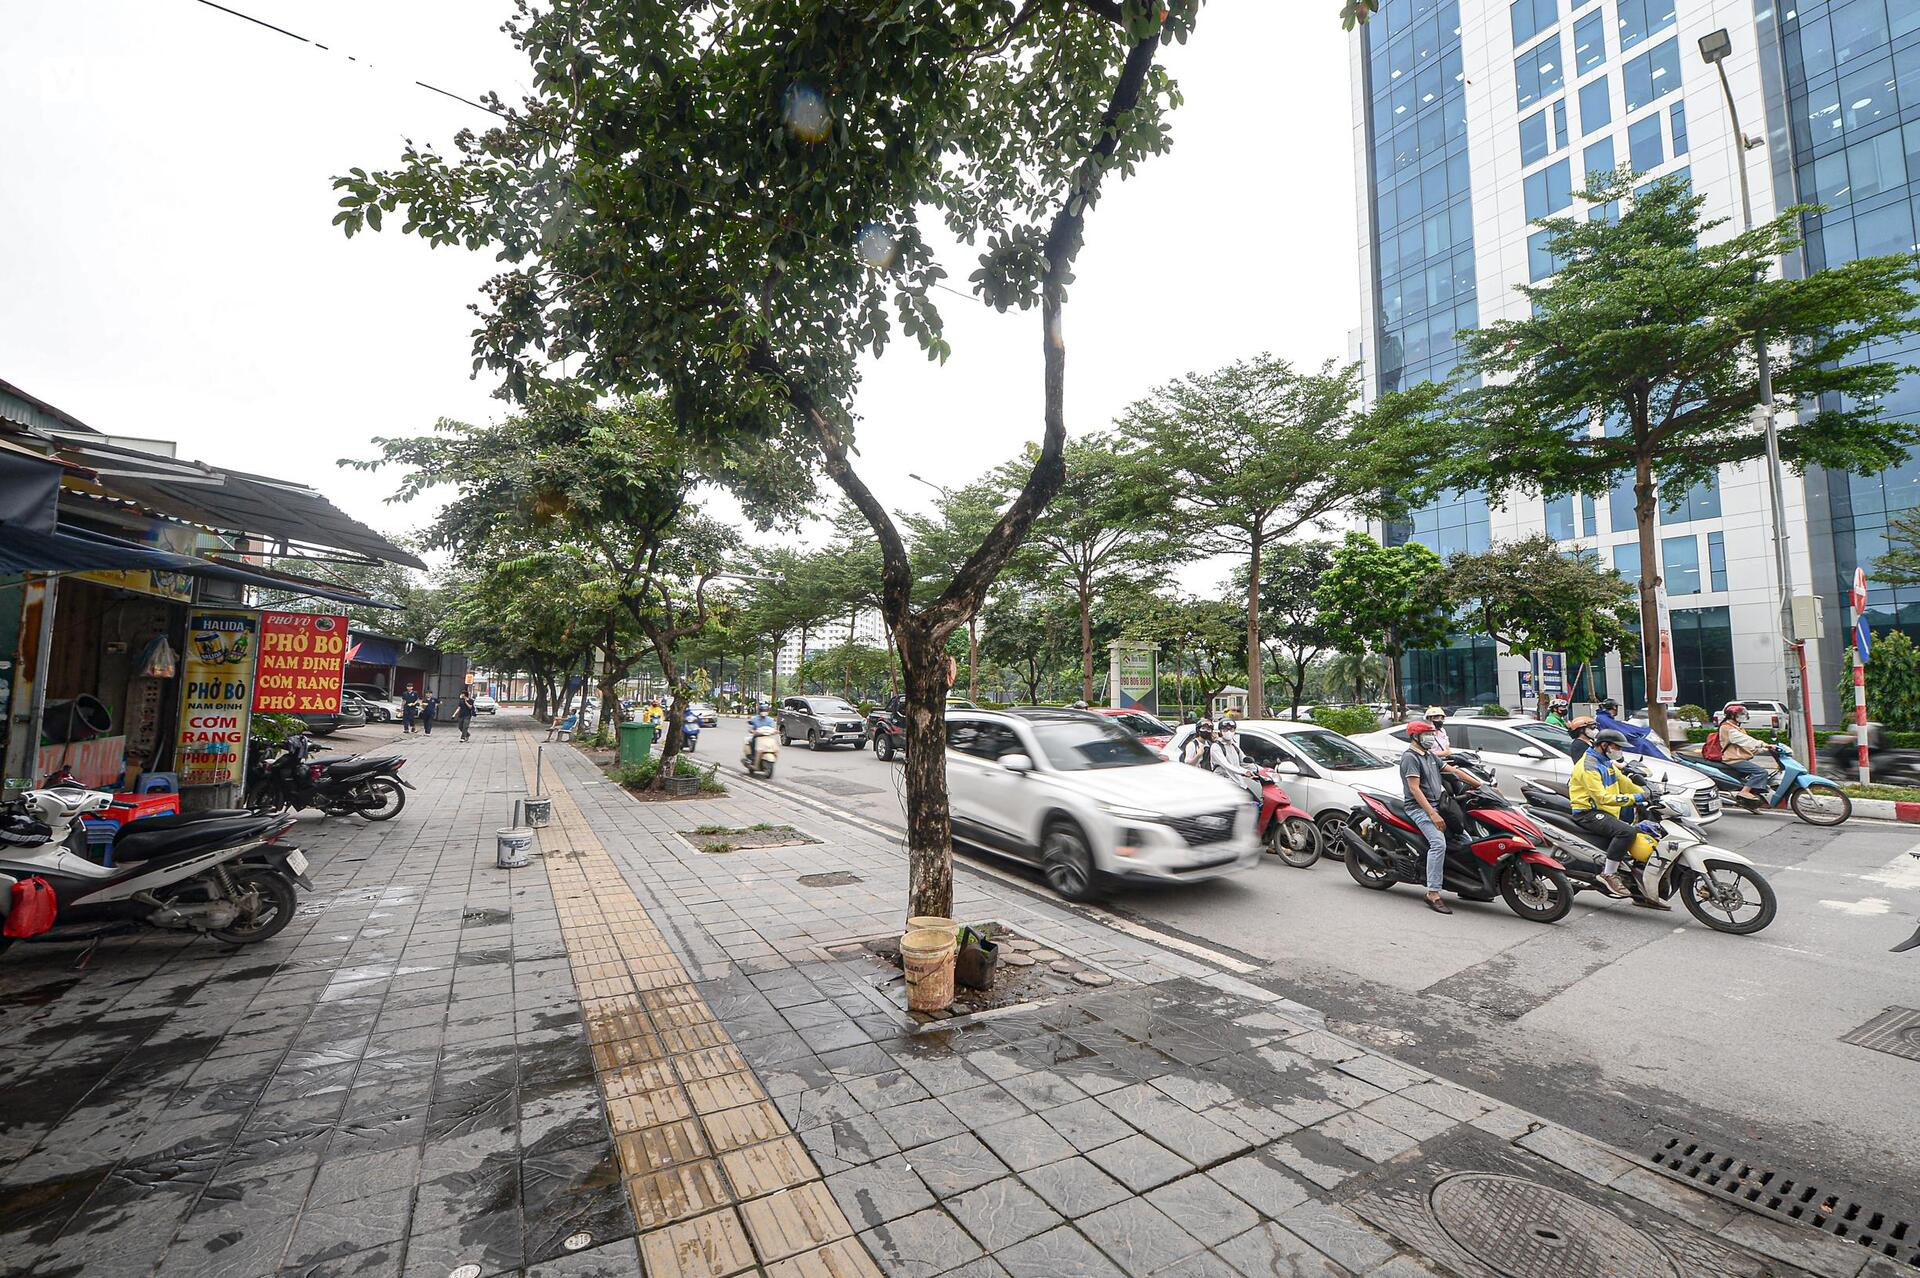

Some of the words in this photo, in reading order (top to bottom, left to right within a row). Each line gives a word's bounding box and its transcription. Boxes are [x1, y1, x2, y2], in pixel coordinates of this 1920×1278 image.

[203, 620, 244, 631] HALIDA
[267, 614, 293, 625] PHỞ
[263, 628, 309, 652] PHỞ
[314, 631, 343, 654] BÒ
[264, 656, 298, 670] NAM
[303, 657, 340, 673] ĐỊNH
[188, 678, 221, 700] PHỞ
[224, 680, 245, 700] BÒ
[260, 674, 293, 689] CƠM
[297, 676, 340, 690] RANG
[214, 703, 242, 711] ĐỊNH
[259, 692, 296, 709] PHỞ
[300, 694, 337, 710] XÀO
[189, 715, 237, 728] CƠM
[182, 732, 241, 743] RANG
